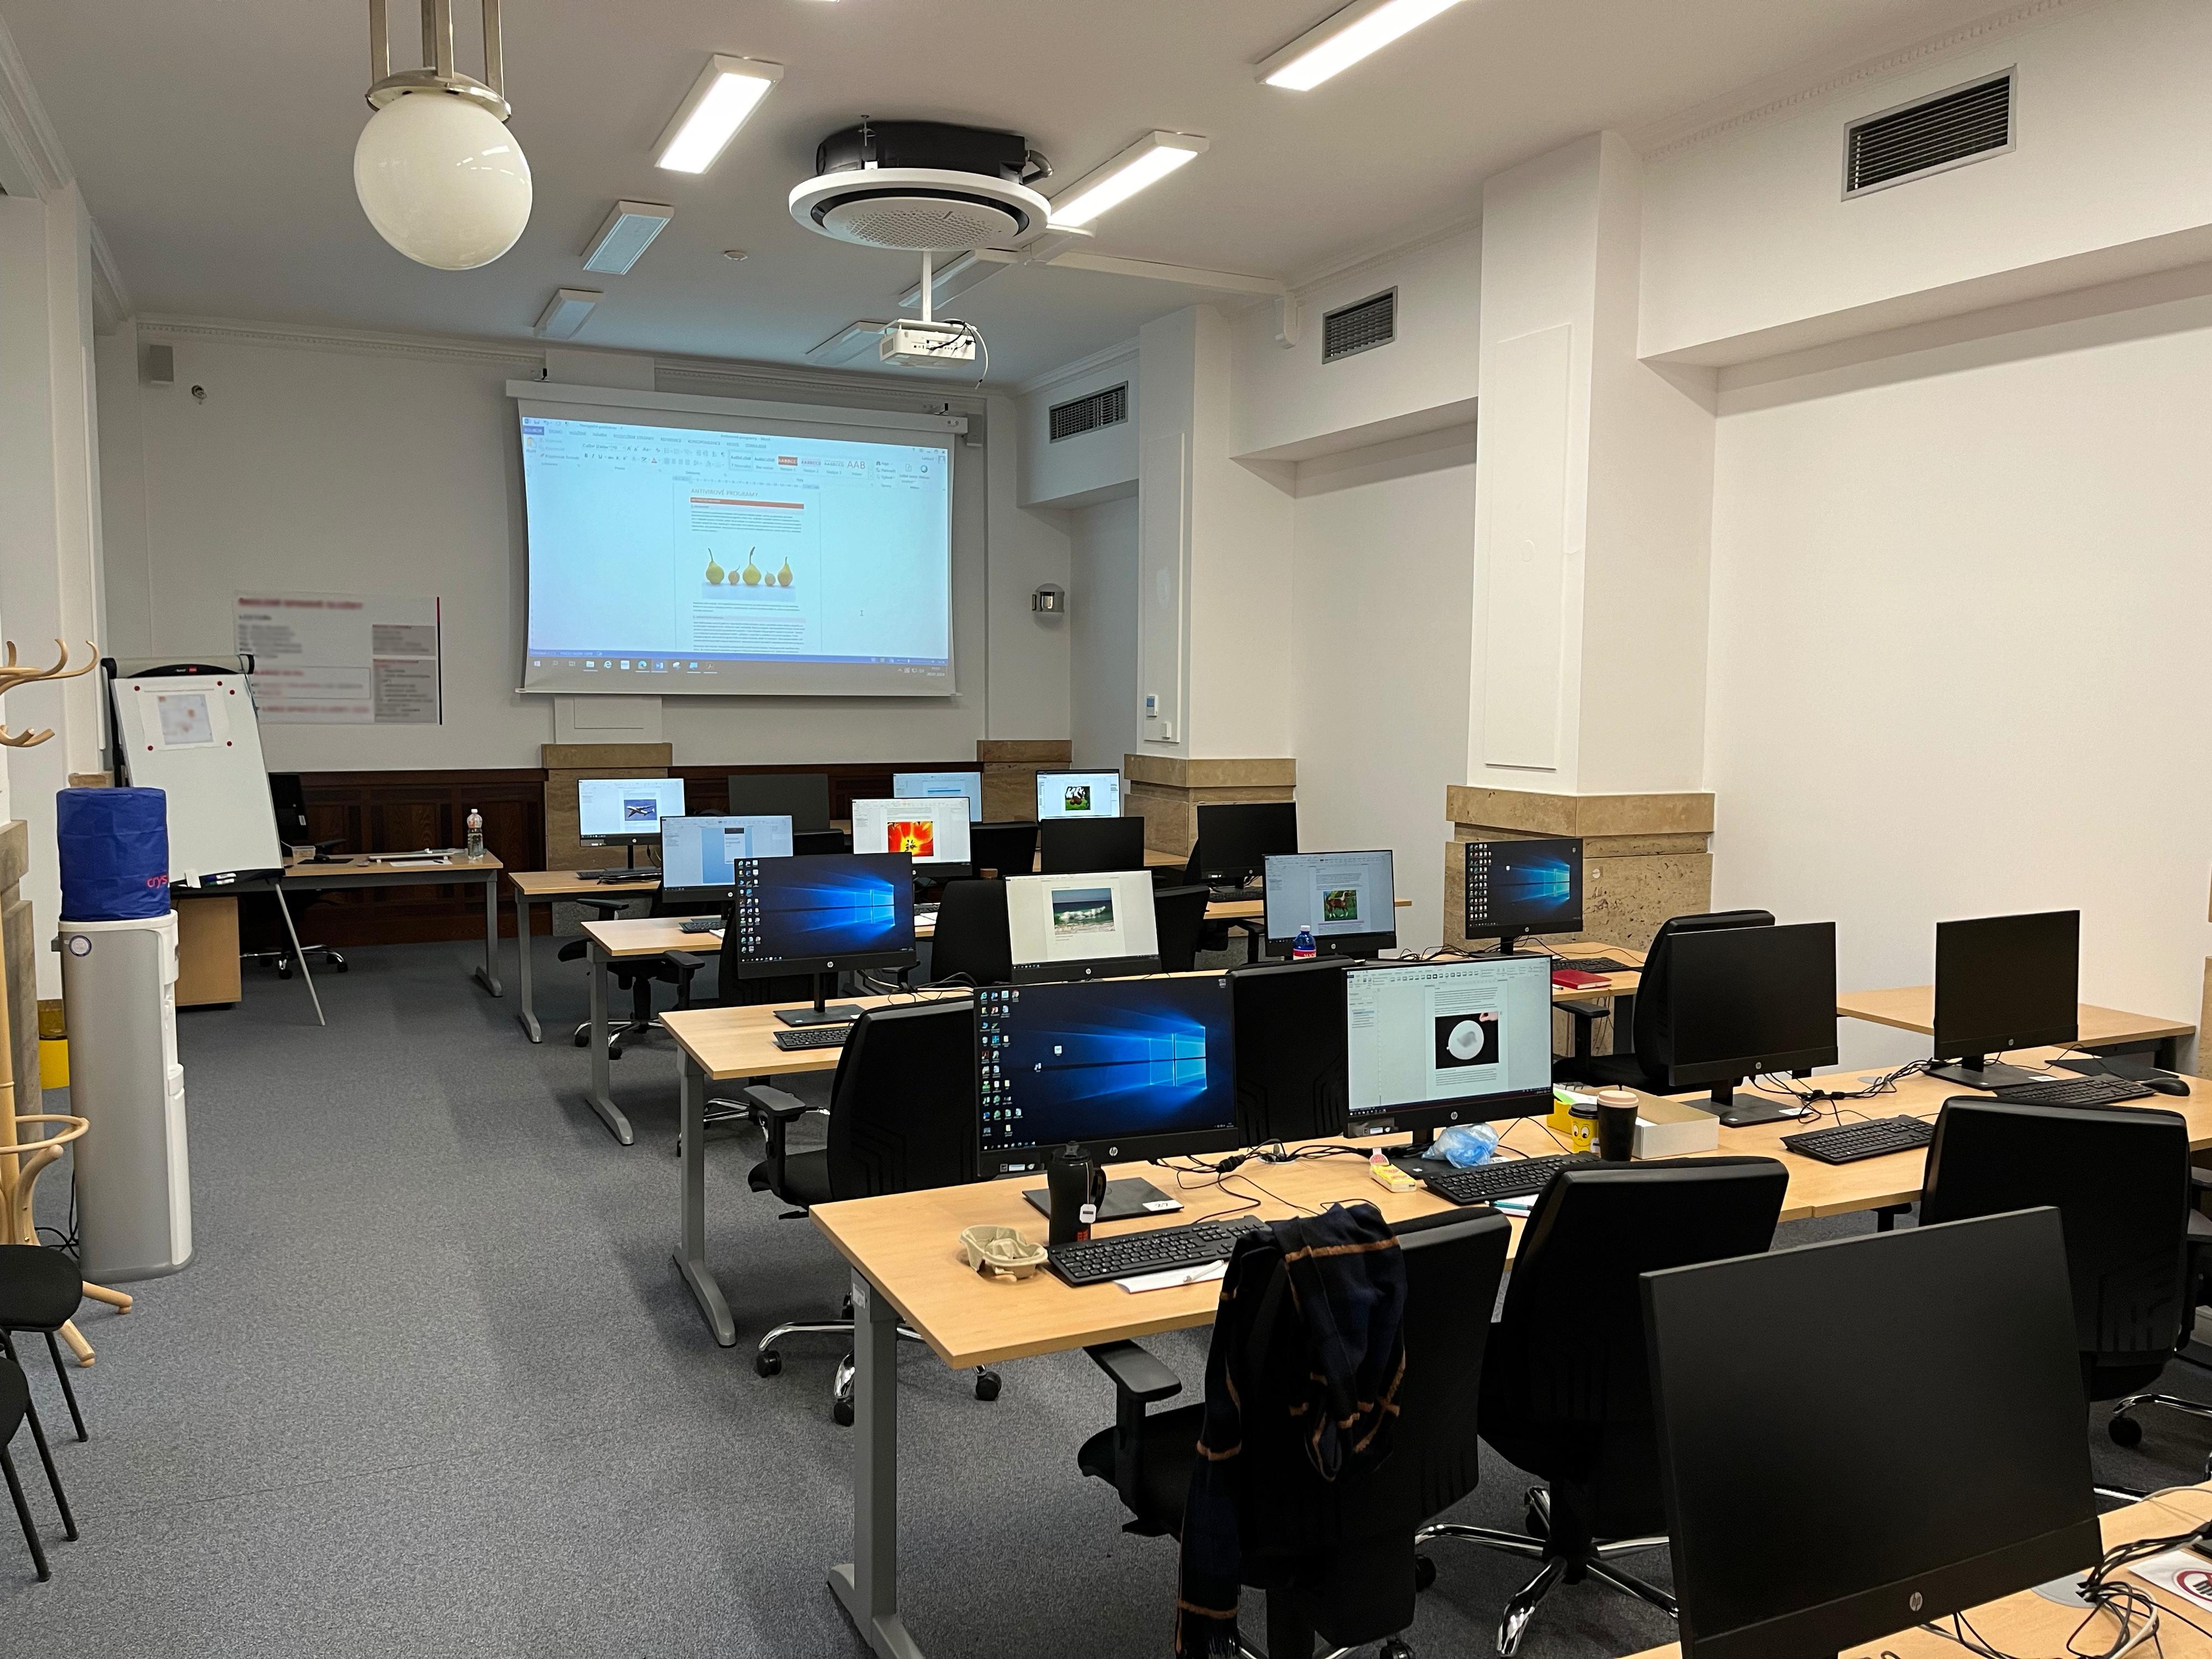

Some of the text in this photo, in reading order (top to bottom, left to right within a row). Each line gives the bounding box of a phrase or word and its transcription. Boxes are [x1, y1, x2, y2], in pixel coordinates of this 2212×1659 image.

[847, 460, 865, 469] AAB
[691, 488, 724, 496] ANTIVIROVÉ
[1910, 1592, 1922, 1611] hp
